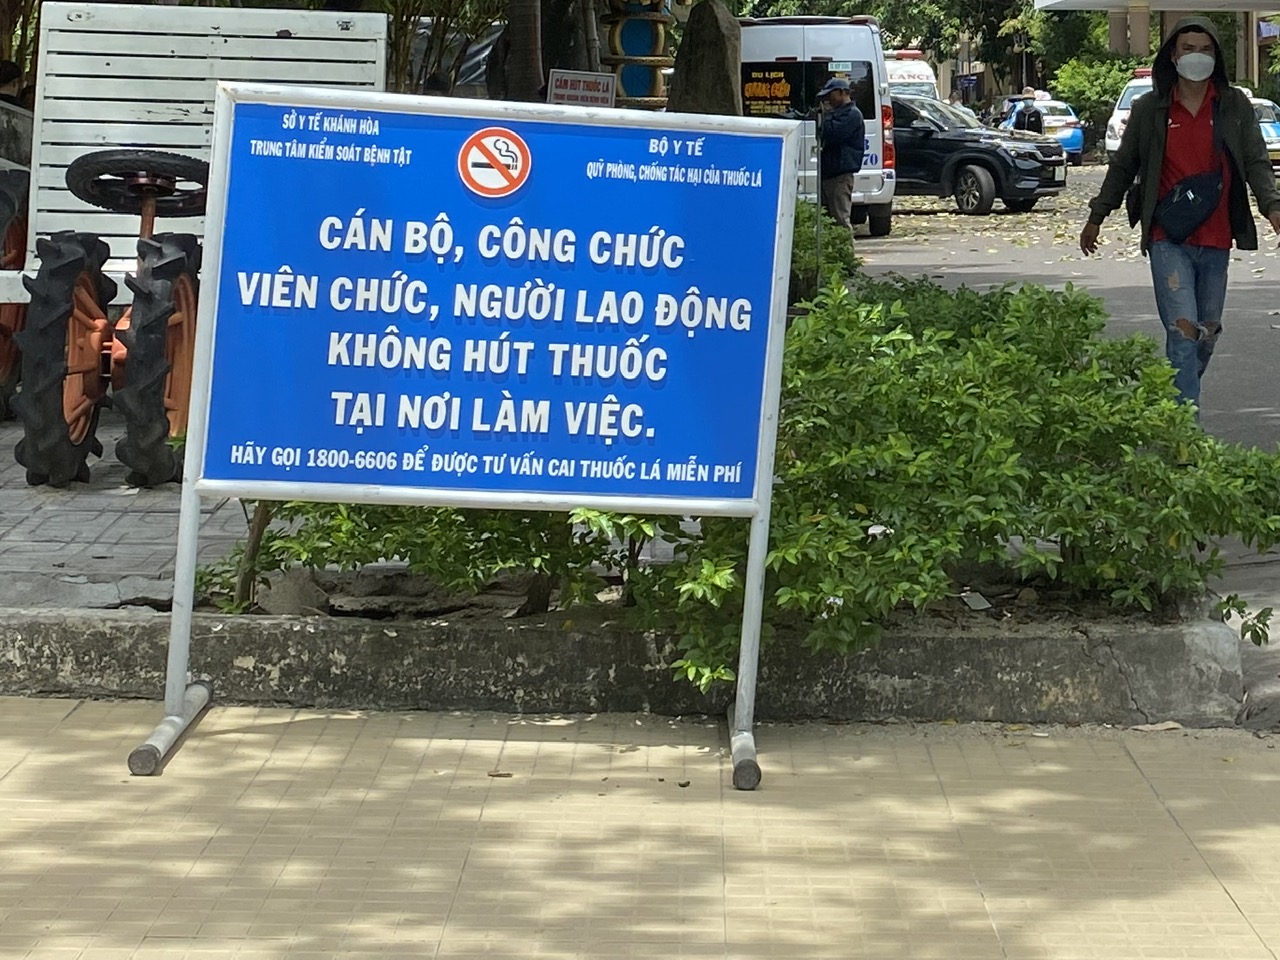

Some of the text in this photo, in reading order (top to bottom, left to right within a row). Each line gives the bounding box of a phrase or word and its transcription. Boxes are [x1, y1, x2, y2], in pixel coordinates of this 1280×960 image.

[282, 109, 379, 135] SỞ Y TẾ KHÁNH HÒA
[250, 137, 412, 167] TRUNG TÂM KIỂM SOÁT BỆNH TẬT
[649, 136, 706, 156] BỘ Y TẾ
[586, 158, 762, 187] QUỸ PHÒNG, CHỐNG TÁC HẠI CỦA THUỐC LÁ
[319, 208, 685, 268] CÁN BỘ, CÔNG CHỨC
[237, 265, 752, 338] VIÊN CHỨC, NGƯỜI LAO ĐỘNG
[328, 325, 668, 381] KHÔNG HÚT THUỐC
[331, 390, 655, 445] TẠI NƠI LÀM VIỆC.
[231, 441, 742, 483] HÃY GỌI 1800-6606 ĐỂ ĐƯỢC TƯ VẤN CAI THUỐC LÁ MIỄN PHÍ
